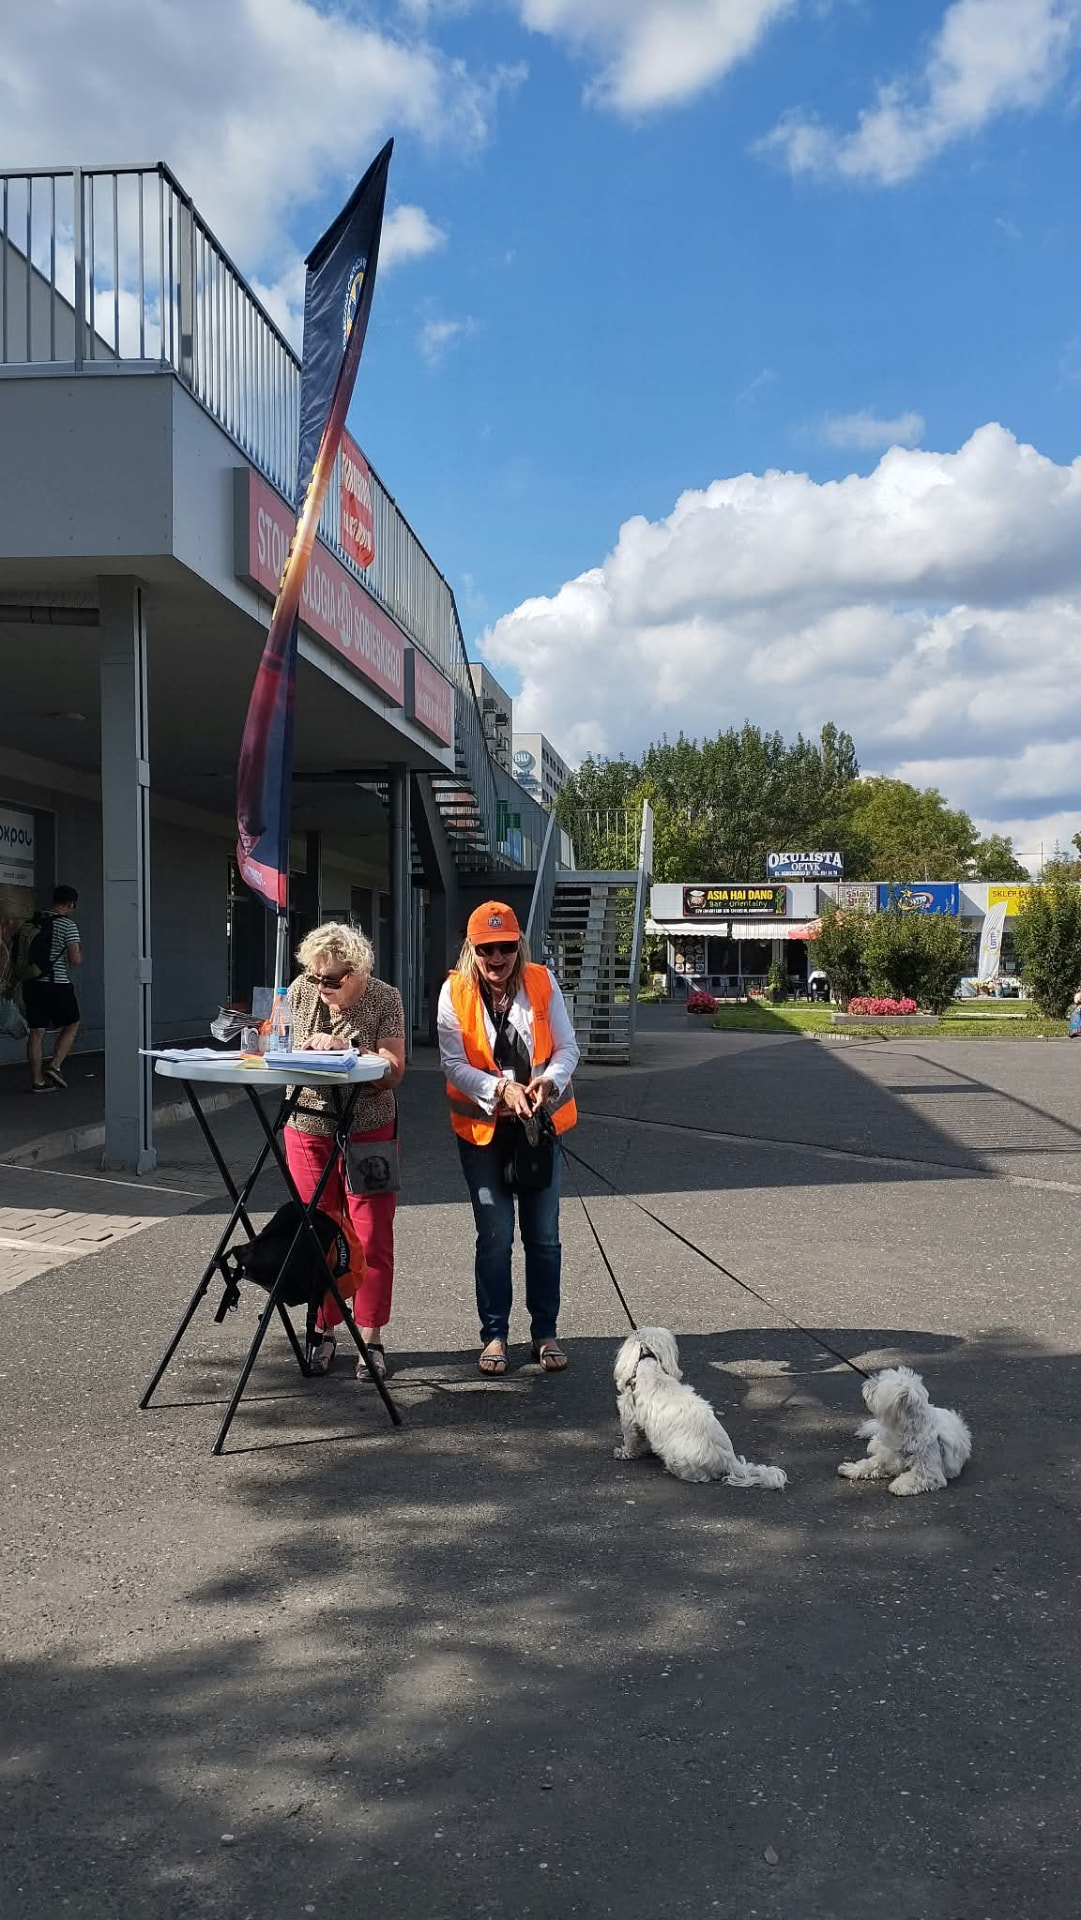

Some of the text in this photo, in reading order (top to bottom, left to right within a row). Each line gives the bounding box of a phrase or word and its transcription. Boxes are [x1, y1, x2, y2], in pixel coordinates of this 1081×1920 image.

[768, 852, 843, 868] OKULISTA
[791, 862, 821, 871] OPTYK
[707, 890, 773, 900] ASIA HAI DANG
[992, 890, 1017, 898] SKLEP
[709, 900, 722, 908] Bar
[729, 900, 767, 909] Orientalny
